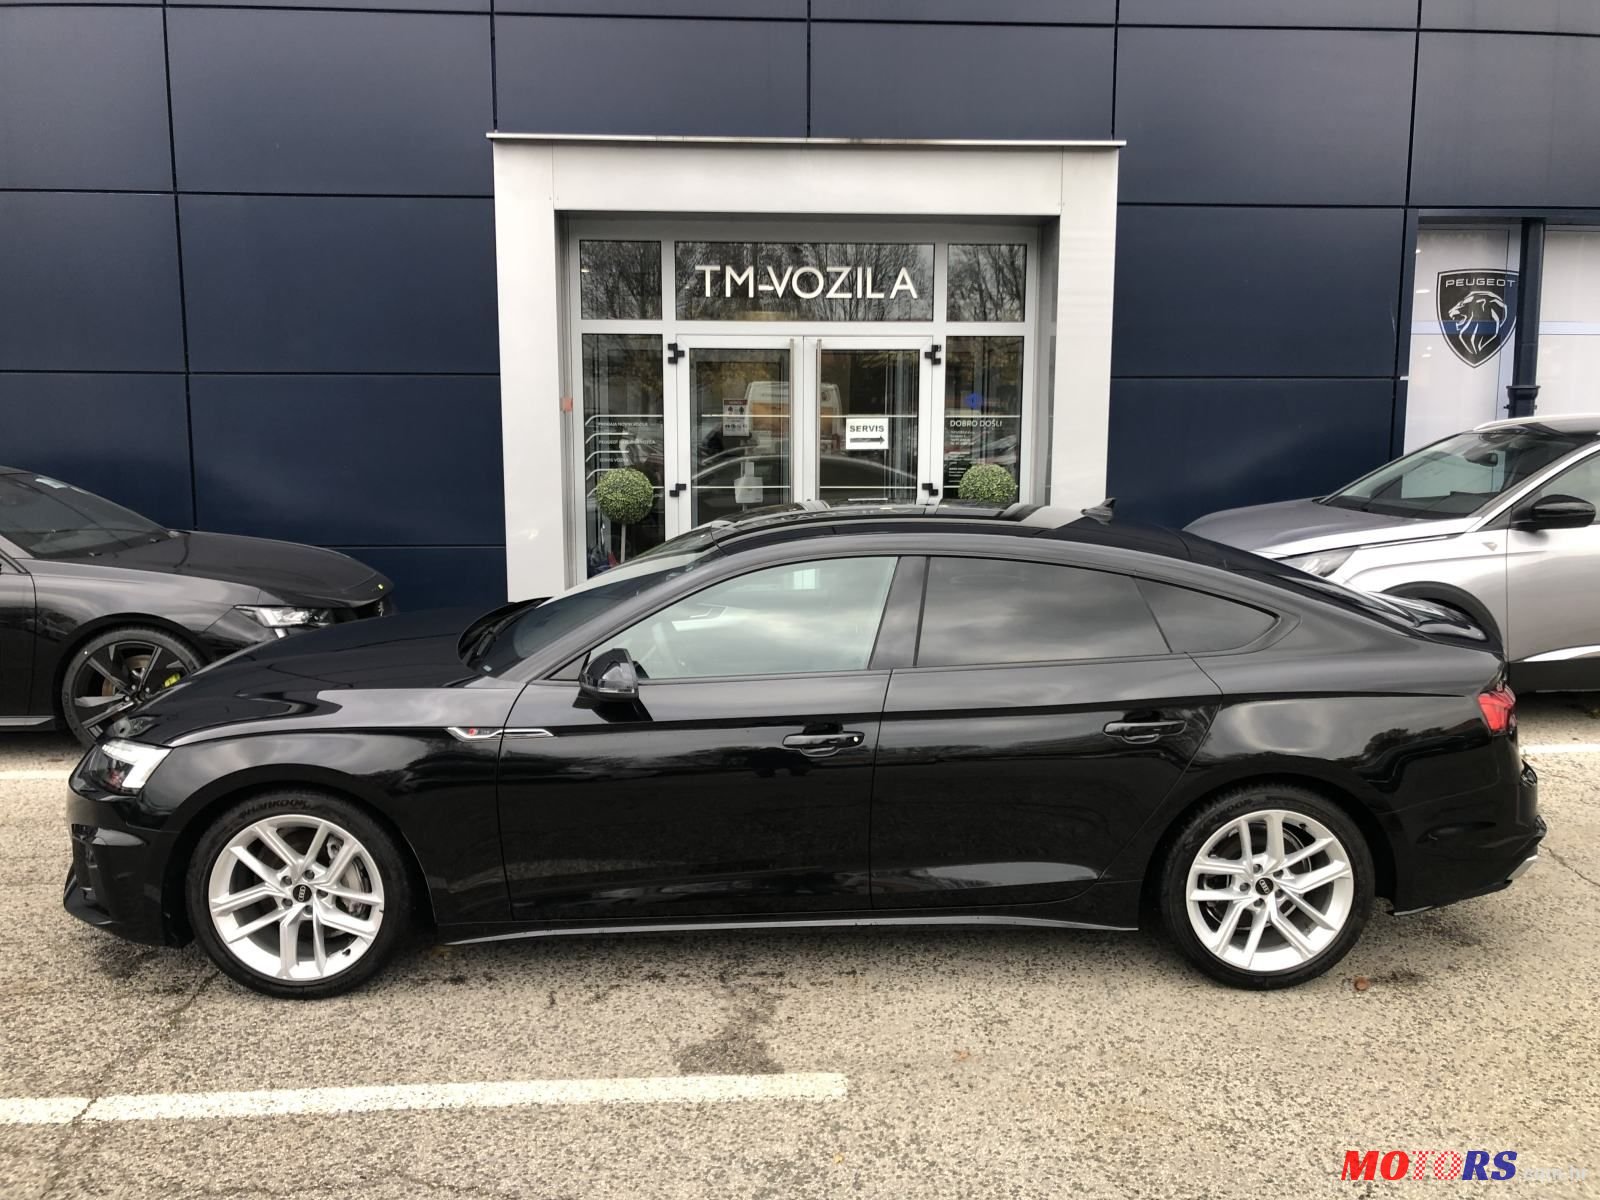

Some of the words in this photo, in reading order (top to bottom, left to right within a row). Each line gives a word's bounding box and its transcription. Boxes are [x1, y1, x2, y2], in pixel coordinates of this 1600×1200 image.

[694, 265, 918, 299] TM-VOZILA
[1445, 278, 1517, 288] PEUGEOT
[949, 419, 978, 427] DOBRO
[849, 424, 885, 433] SERVIS
